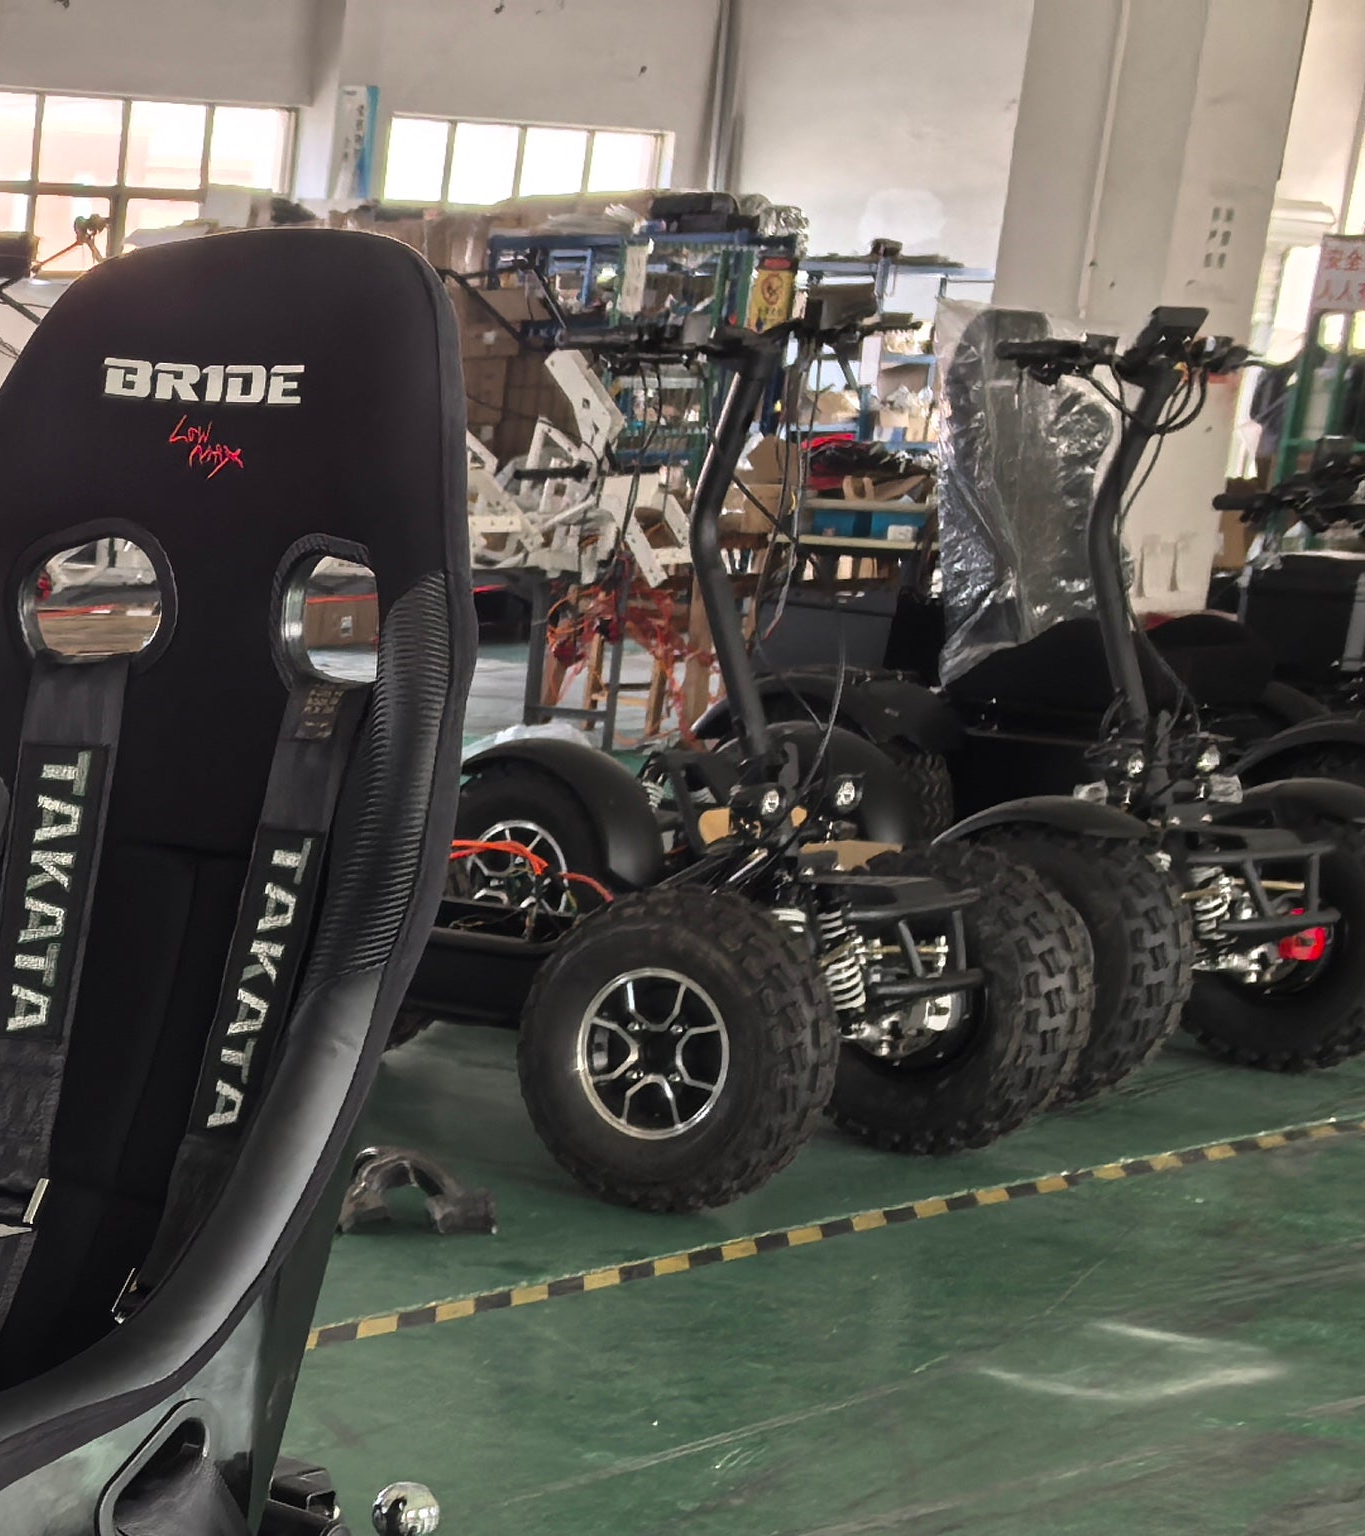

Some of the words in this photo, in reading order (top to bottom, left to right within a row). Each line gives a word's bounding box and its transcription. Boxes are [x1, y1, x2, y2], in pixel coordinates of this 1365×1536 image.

[104, 357, 305, 405] BRIDE
[5, 751, 93, 1032] TAKATA
[206, 837, 314, 1129] TAKATA
